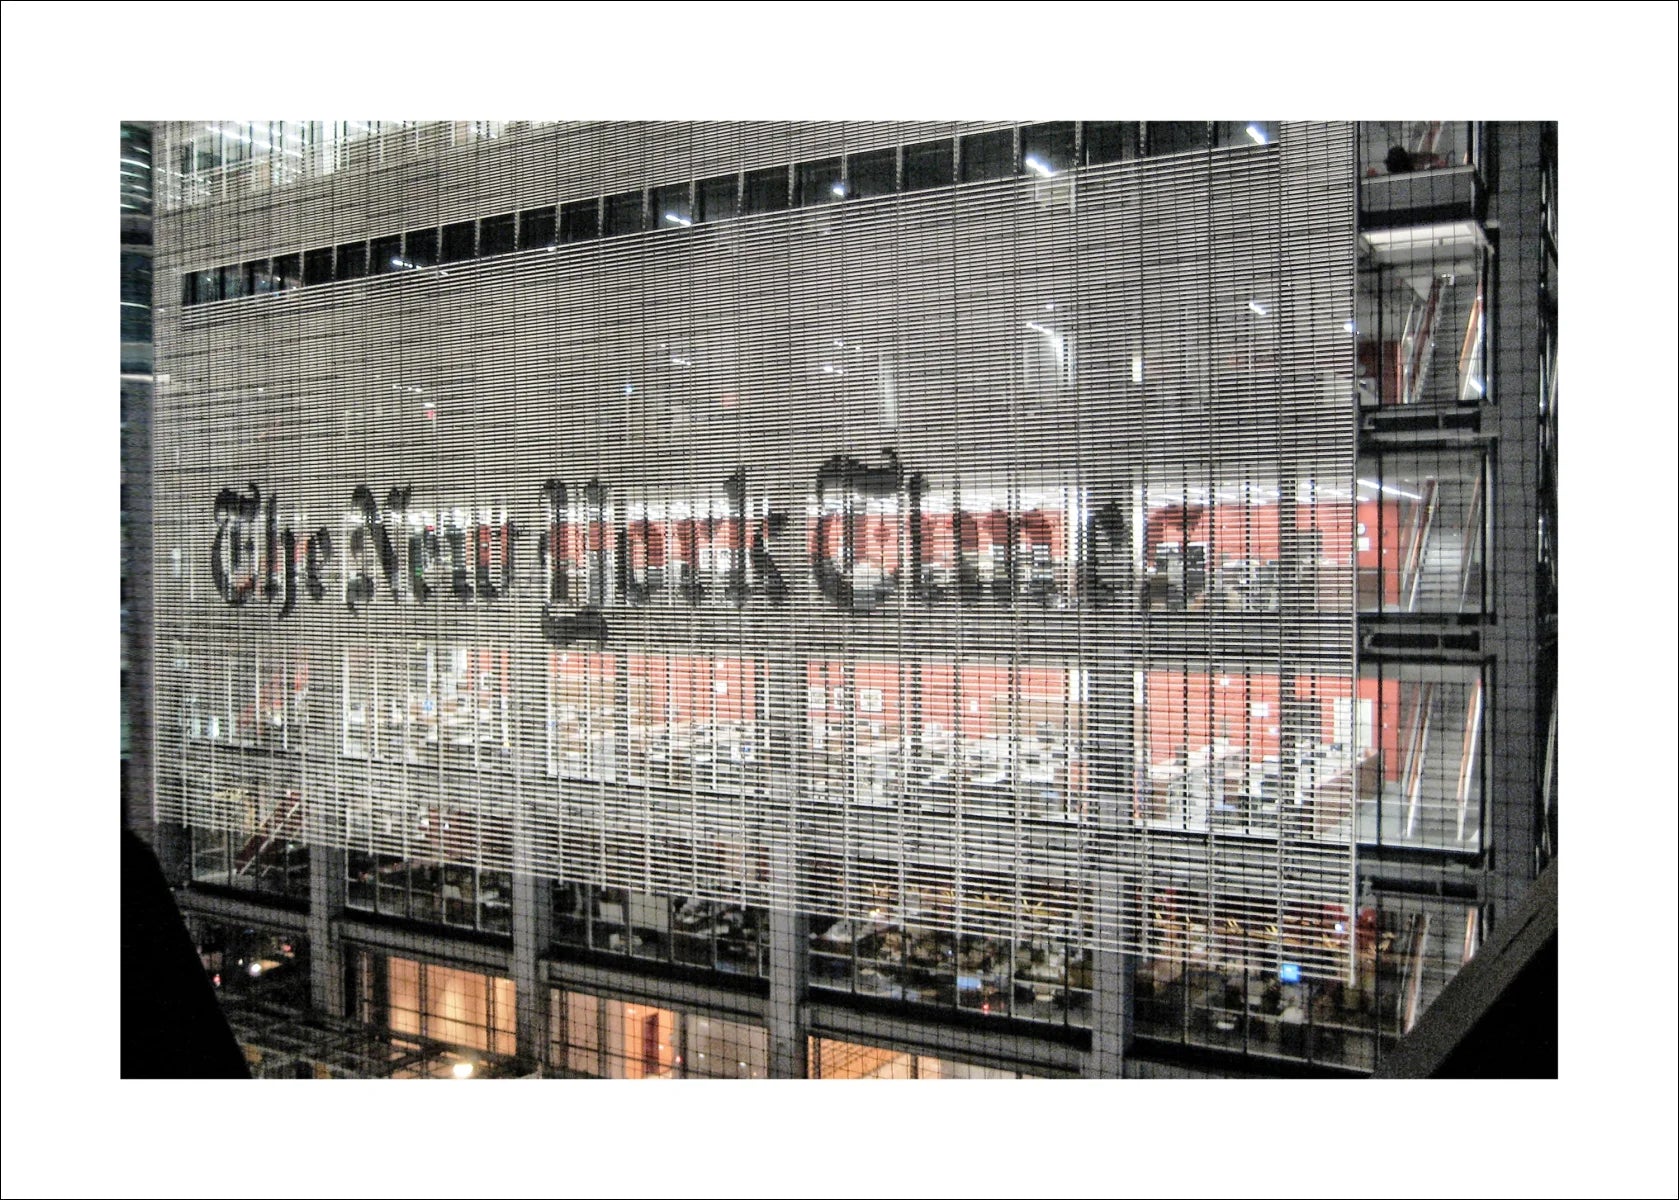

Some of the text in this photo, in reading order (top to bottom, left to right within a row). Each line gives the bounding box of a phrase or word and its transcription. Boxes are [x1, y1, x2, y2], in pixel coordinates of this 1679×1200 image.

[211, 447, 1207, 646] The New York Times
